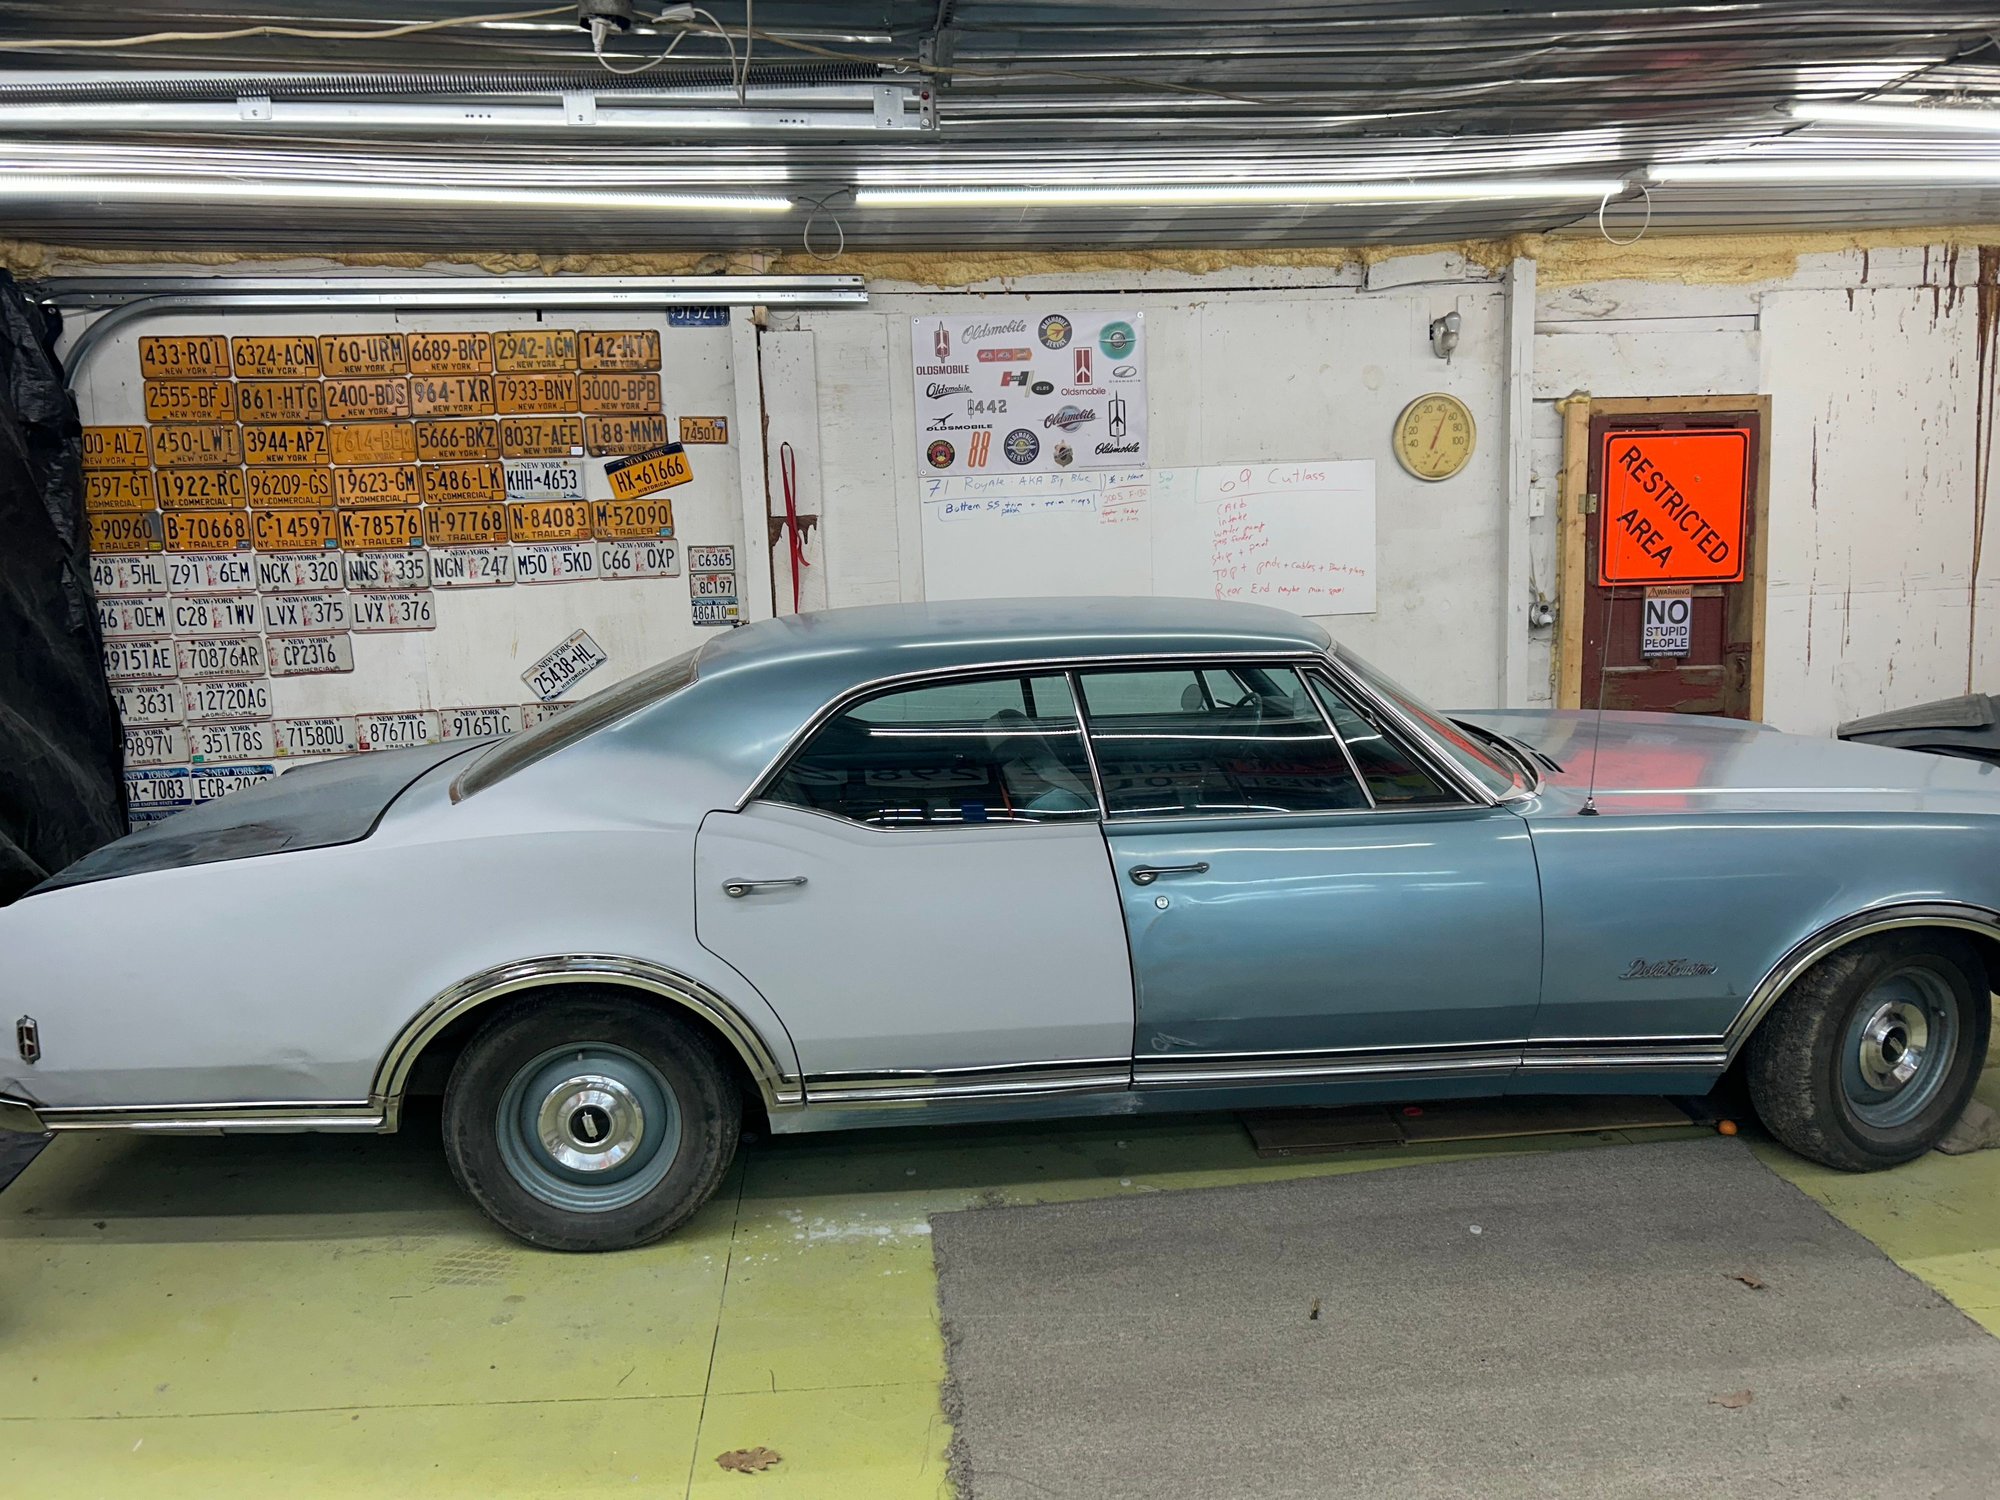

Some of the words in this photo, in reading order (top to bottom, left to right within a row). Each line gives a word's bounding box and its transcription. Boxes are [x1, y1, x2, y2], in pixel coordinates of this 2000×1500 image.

[961, 320, 1027, 344] Oldsmobile
[237, 344, 315, 366] 6324-ACN
[325, 338, 403, 363] 760-URM
[412, 339, 487, 361] 6689-BKP
[498, 336, 575, 359] 2942-AGM
[916, 365, 970, 376] OLDSMOBILE
[149, 386, 230, 408] 2555-BFJ
[242, 387, 317, 409] 861-HTG
[328, 384, 406, 407] 2400-BDS
[414, 379, 489, 403] 964-TXR
[498, 379, 573, 401] 7933-BNY
[582, 379, 655, 401] 3000-BPB
[926, 382, 971, 399] Oldsmobile
[1061, 387, 1106, 396] Oldsmobile
[975, 400, 1007, 413] 442
[1044, 409, 1096, 429] Oldsmobile
[247, 430, 326, 452] 3944-APZ
[419, 427, 496, 449] 5666-BKZ
[505, 425, 579, 446] 8037-AEE
[592, 420, 664, 443] 188-MNM
[684, 426, 724, 441] 745017
[624, 456, 643, 467] NEW
[644, 450, 665, 461] YORK
[1095, 442, 1140, 455] Oldsmobile
[540, 461, 562, 469] YORK
[615, 470, 637, 493] HX
[642, 456, 685, 485] 61666
[1268, 468, 1325, 484] Cutlass
[162, 473, 240, 497] 1922-RC
[251, 474, 328, 496] 96209-GS
[339, 471, 415, 494] 19623-GM
[426, 468, 501, 491] 5486-LK
[638, 480, 671, 494] HISTORICAL
[927, 479, 949, 497] 71
[1019, 476, 1043, 486] AKA
[1071, 474, 1092, 482] Blue
[89, 499, 136, 508] COMMERCIAL
[179, 498, 227, 506] COMMERCIAL
[268, 496, 314, 504] COMMERCIAL
[355, 495, 402, 503] COMMERCIAL
[442, 492, 488, 500] COMMERCIAL
[1618, 445, 1729, 564] RESTRICTED
[257, 516, 330, 538] C-14597
[343, 515, 417, 537] K-78576
[429, 511, 501, 533] H-97768
[514, 507, 586, 529] N-84083
[596, 505, 668, 527] M-52090
[168, 517, 245, 539] B-70668
[1616, 508, 1673, 568] AREA
[188, 540, 229, 548] TRAILER
[349, 560, 379, 581] NNS
[395, 559, 424, 580] 335
[434, 558, 464, 578] NGN
[480, 556, 508, 576] 247
[698, 553, 732, 567] C6365
[131, 564, 162, 584] 5HL
[170, 564, 199, 585] Z91
[220, 562, 250, 582] 6EM
[260, 563, 292, 584] NCK
[308, 561, 338, 582] 320
[699, 581, 732, 594] 8C197
[1251, 583, 1270, 595] End
[1658, 588, 1689, 596] WARNING
[267, 605, 297, 626] LVX
[313, 602, 344, 622] 375
[355, 602, 384, 623] LVX
[401, 601, 430, 621] 376
[693, 606, 727, 620] 48GA10
[1646, 599, 1689, 625] NO
[1646, 626, 1687, 637] STUPID
[1645, 638, 1687, 648] PEOPLE
[188, 647, 259, 668] 70876AR
[283, 644, 336, 666] CP2316
[539, 654, 554, 671] NEW
[553, 642, 573, 658] YORK
[534, 658, 575, 695] 25438
[572, 644, 596, 664] HL
[561, 667, 588, 689] HISTORICAL
[114, 694, 128, 715] A
[136, 693, 174, 714] 3631
[197, 688, 267, 711] 12720AG
[287, 725, 344, 747] 71580U
[370, 720, 427, 742] 87671G
[453, 715, 511, 737] 91651C
[203, 731, 262, 754] 35178S
[127, 772, 145, 780] NEW
[147, 770, 169, 779] YORK
[211, 768, 230, 776] NEW
[232, 767, 255, 776] YORK
[149, 779, 184, 800] 7083
[199, 777, 225, 798] ECB
